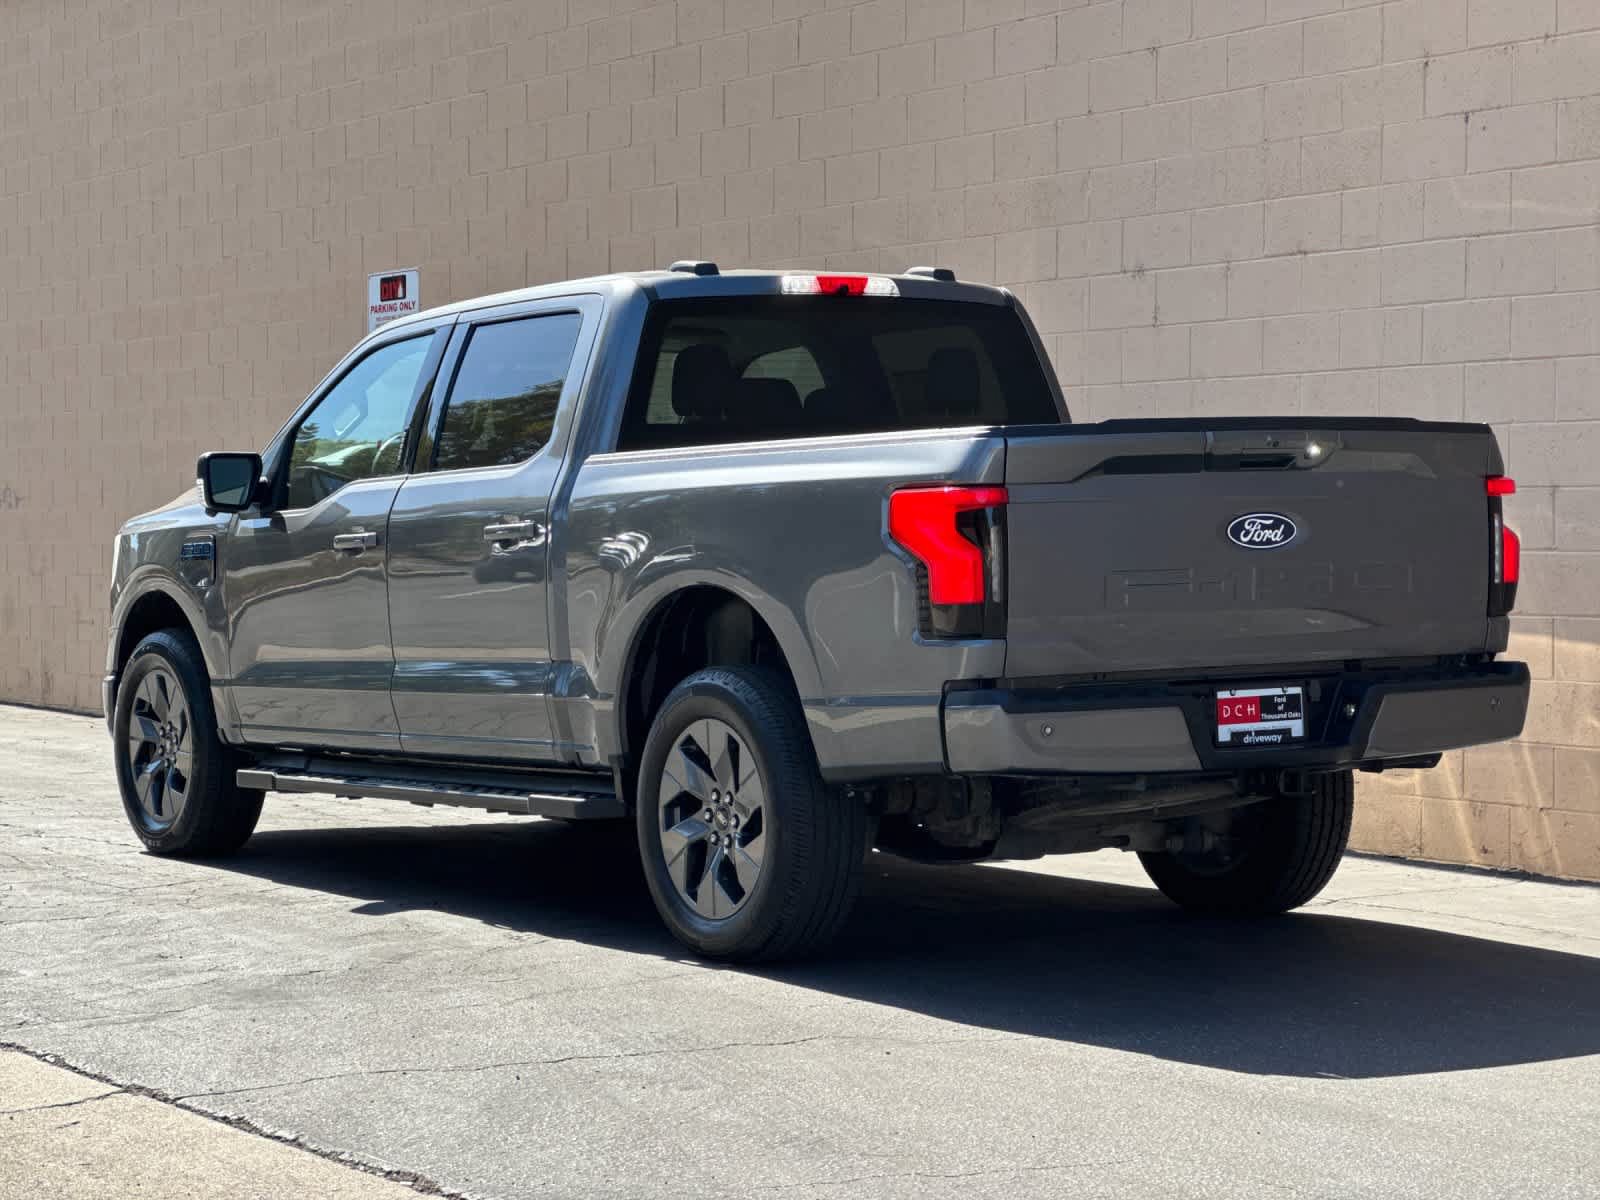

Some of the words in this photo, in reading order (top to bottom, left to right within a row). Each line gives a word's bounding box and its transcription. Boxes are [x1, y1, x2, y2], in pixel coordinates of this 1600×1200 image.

[370, 303, 398, 313] PARKING
[399, 300, 416, 311] ONLY
[1240, 518, 1285, 542] Ford
[1261, 712, 1287, 720] Thousand
[1288, 711, 1302, 719] Oaks
[1243, 731, 1282, 744] driveway
